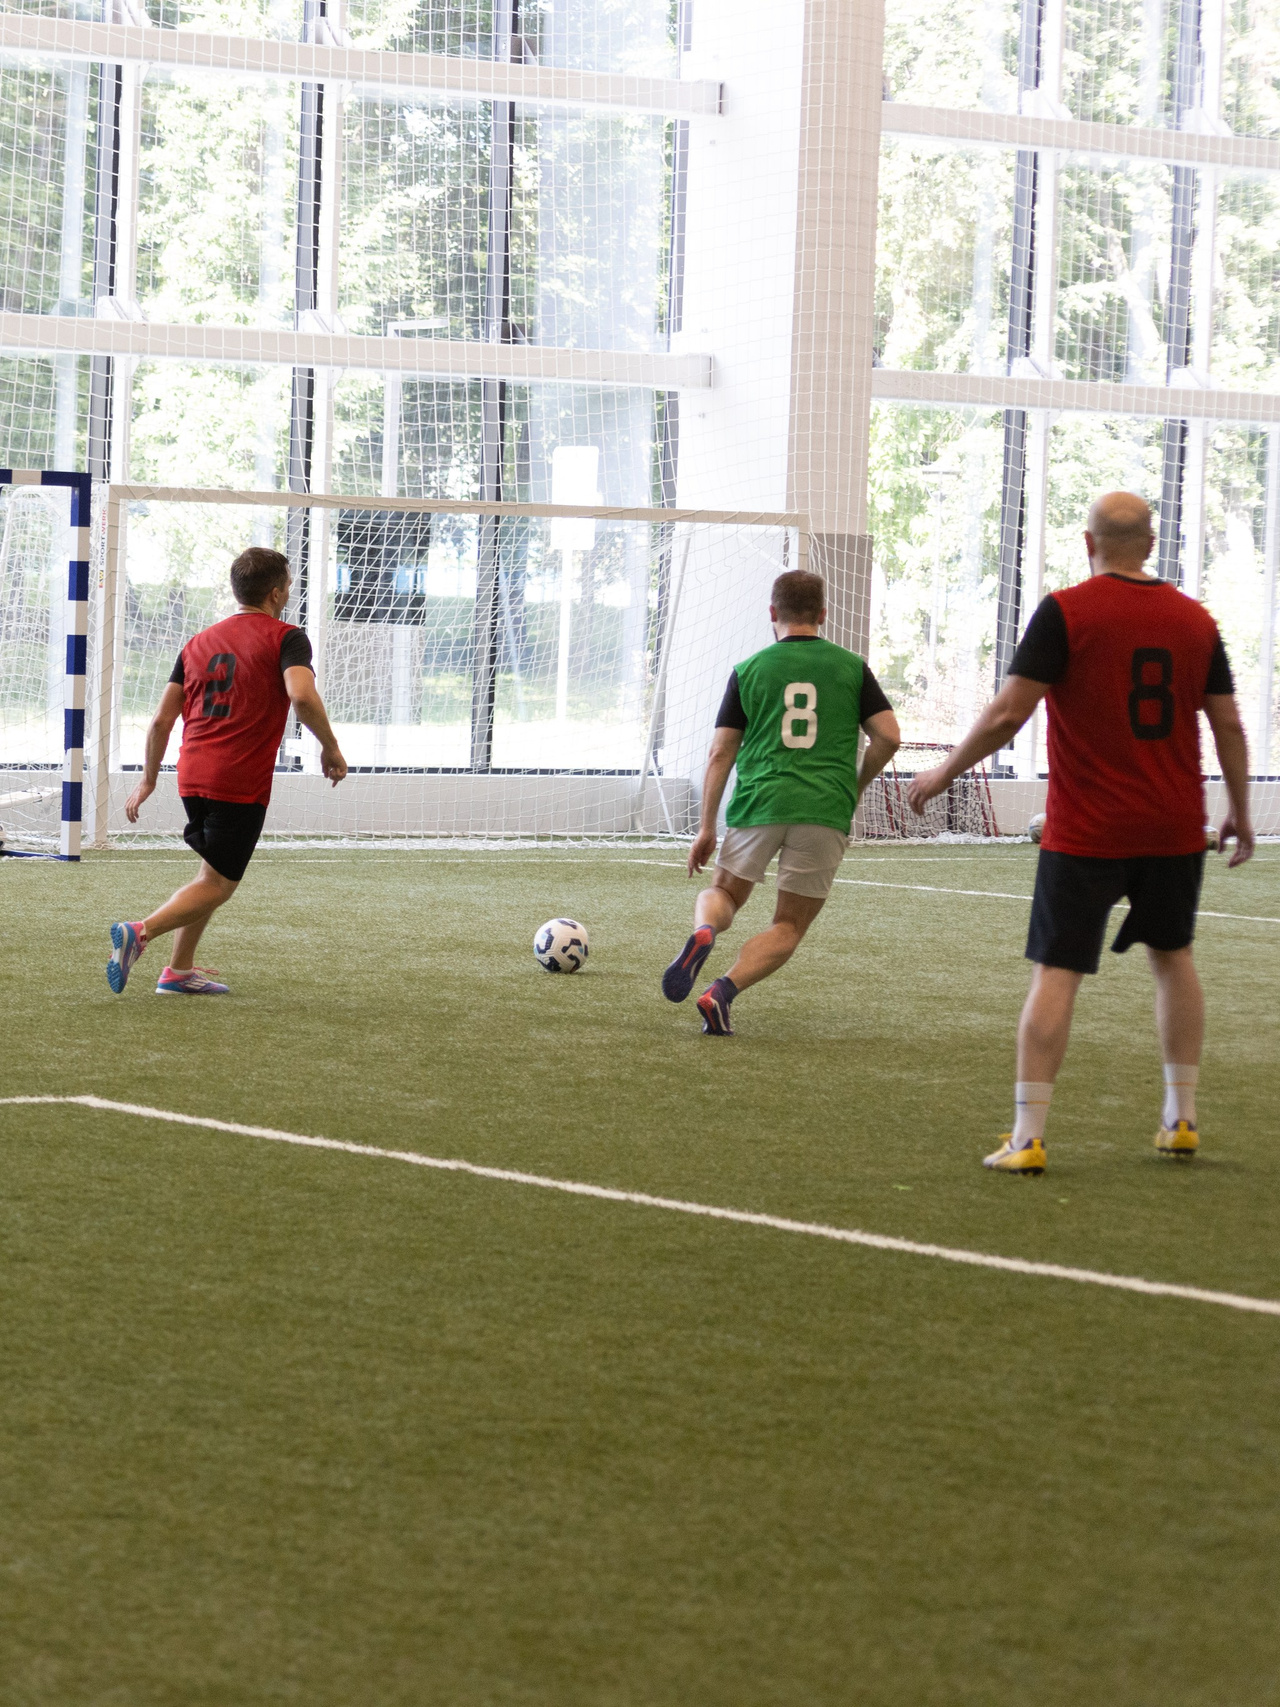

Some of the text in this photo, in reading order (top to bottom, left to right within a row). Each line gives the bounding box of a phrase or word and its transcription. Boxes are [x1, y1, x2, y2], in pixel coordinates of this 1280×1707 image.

[202, 653, 236, 718] 2
[781, 682, 818, 749] 8
[1128, 647, 1175, 740] 8
